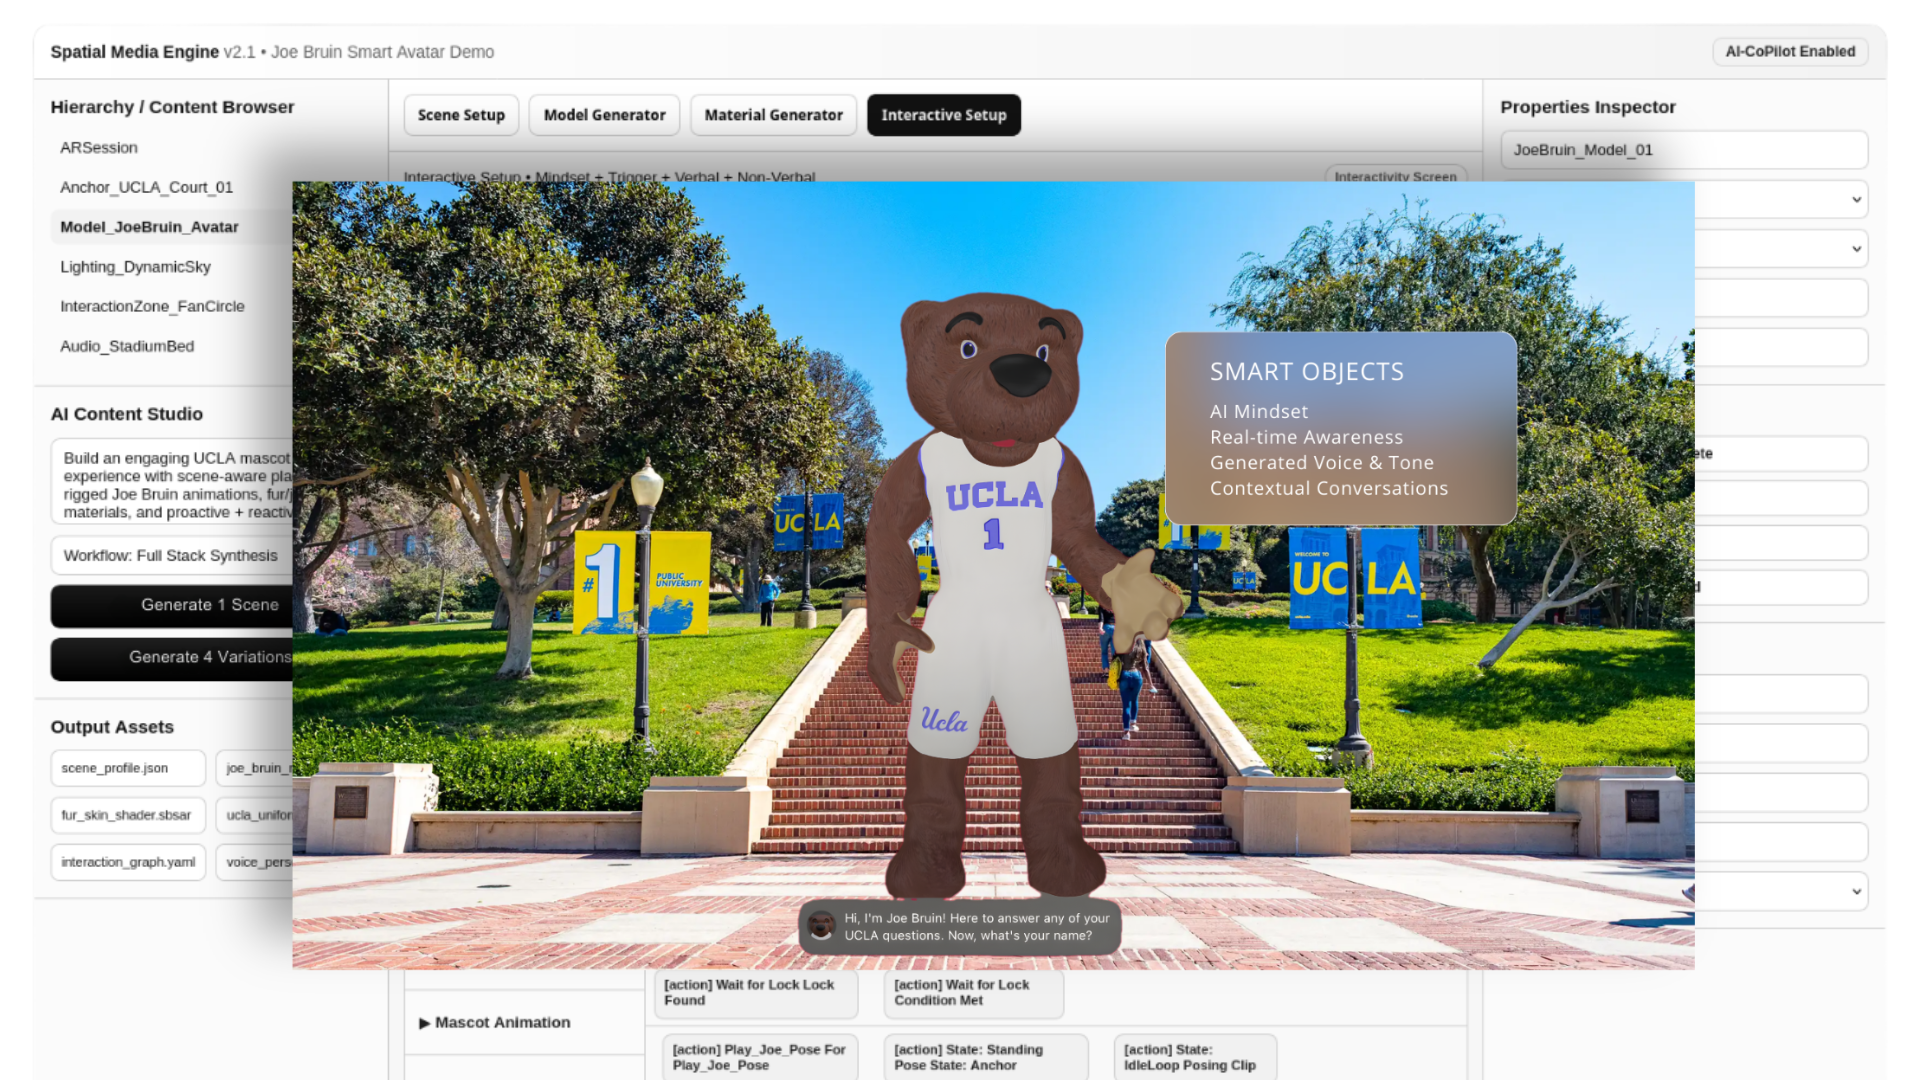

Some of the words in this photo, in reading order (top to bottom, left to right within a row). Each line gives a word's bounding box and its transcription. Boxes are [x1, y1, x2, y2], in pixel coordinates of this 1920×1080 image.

[50, 43, 106, 63] Spatial
[110, 43, 160, 59] Media
[162, 43, 220, 63] Engine
[223, 45, 256, 59] v2.1
[271, 45, 299, 59] Joe
[303, 44, 343, 59] Bruin
[347, 45, 393, 59] Smart
[396, 45, 446, 59] Avatar
[450, 45, 495, 59] Demo
[1725, 44, 1797, 58] AI-CoPilot
[1799, 44, 1856, 58] Enabled
[50, 99, 135, 118] Hierarchy
[138, 99, 145, 114] /
[148, 100, 218, 114] Content
[222, 100, 296, 114] Browser
[543, 107, 589, 122] Model
[591, 108, 667, 122] Generator
[704, 107, 766, 122] Material
[769, 108, 844, 122] Generator
[881, 107, 963, 122] Interactive
[965, 108, 1008, 125] Setup
[1500, 99, 1591, 119] Properties
[1595, 100, 1677, 118] Inspector
[417, 108, 461, 122] Scene
[463, 108, 506, 126] Setup
[59, 141, 138, 155] ARSession
[1513, 143, 1654, 161] JoeBruin_Model_01
[403, 172, 477, 182] Interactive
[479, 172, 522, 182] Setup
[534, 172, 591, 182] Mindset
[674, 172, 720, 182] Verbal
[737, 172, 816, 182] Non-Verbal
[1334, 172, 1411, 182] Interactivity
[1412, 172, 1458, 182] Screen
[59, 180, 234, 198] Anchor_UCLA_Court_01
[60, 220, 240, 236] Model_JoeBruin_Avatar
[60, 260, 212, 277] Lighting_DynamicSky
[60, 299, 246, 317] InteractionZone_FanCircle
[59, 339, 195, 356] Audio_StadiumBed
[50, 406, 69, 422] AI
[73, 406, 143, 422] Content
[147, 406, 204, 422] Studio
[63, 451, 99, 465] Build
[102, 454, 121, 465] an
[124, 451, 190, 468] engaging
[193, 451, 237, 465] UCLA
[239, 453, 291, 465] mascot
[63, 470, 141, 488] experience
[143, 470, 173, 483] with
[176, 471, 267, 483] scene-aware
[63, 487, 108, 504] rigged
[111, 487, 138, 501] Joe
[141, 487, 179, 501] Bruin
[182, 487, 263, 502] animations,
[945, 481, 1044, 512] UCLA
[63, 505, 132, 520] materials,
[135, 505, 163, 519] and
[166, 505, 231, 523] proactive
[983, 518, 1005, 551] 1
[63, 548, 133, 562] Workflow:
[136, 548, 163, 562] Full
[166, 548, 207, 562] Stack
[210, 548, 279, 566] Synthesis
[656, 572, 685, 580] PUBLIC
[656, 580, 704, 588] UNIVERSITY
[140, 597, 213, 612] Generate
[217, 597, 225, 611] 1
[231, 597, 280, 612] Scene
[128, 649, 200, 664] Generate
[202, 649, 214, 663] 4
[217, 649, 292, 664] Variations
[921, 706, 969, 733] Ucla
[50, 719, 111, 738] Output
[114, 719, 175, 735] Assets
[61, 761, 169, 777] scene_profile.json
[61, 809, 192, 823] fur_skin_shader.sbsar
[61, 856, 196, 871] interaction_graph.yaml
[225, 856, 292, 871] voice_pers
[663, 978, 714, 993] [action]
[715, 978, 744, 991] Wait
[746, 978, 766, 991] for
[768, 978, 800, 991] Lock
[802, 979, 835, 991] Lock
[894, 978, 943, 993] [action]
[945, 978, 974, 991] Wait
[976, 978, 996, 991] for
[998, 978, 1030, 991] Lock
[664, 994, 706, 1006] Found
[894, 994, 957, 1006] Condition
[959, 994, 984, 1006] Met
[435, 1016, 490, 1029] Mascot
[493, 1016, 571, 1029] Animation
[672, 1043, 722, 1058] [action]
[724, 1043, 822, 1058] Play_Joe_Pose
[824, 1043, 847, 1056] For
[894, 1043, 943, 1058] [action]
[946, 1043, 983, 1056] State:
[986, 1043, 1044, 1058] Standing
[1124, 1043, 1173, 1058] [action]
[1175, 1043, 1213, 1056] State:
[672, 1059, 770, 1074] Play_Joe_Pose
[894, 1059, 927, 1071] Pose
[929, 1059, 967, 1071] State:
[969, 1059, 1018, 1071] Anchor
[1124, 1059, 1180, 1074] IdleLoop
[1182, 1059, 1228, 1074] Posing
[1230, 1059, 1257, 1074] Clip
